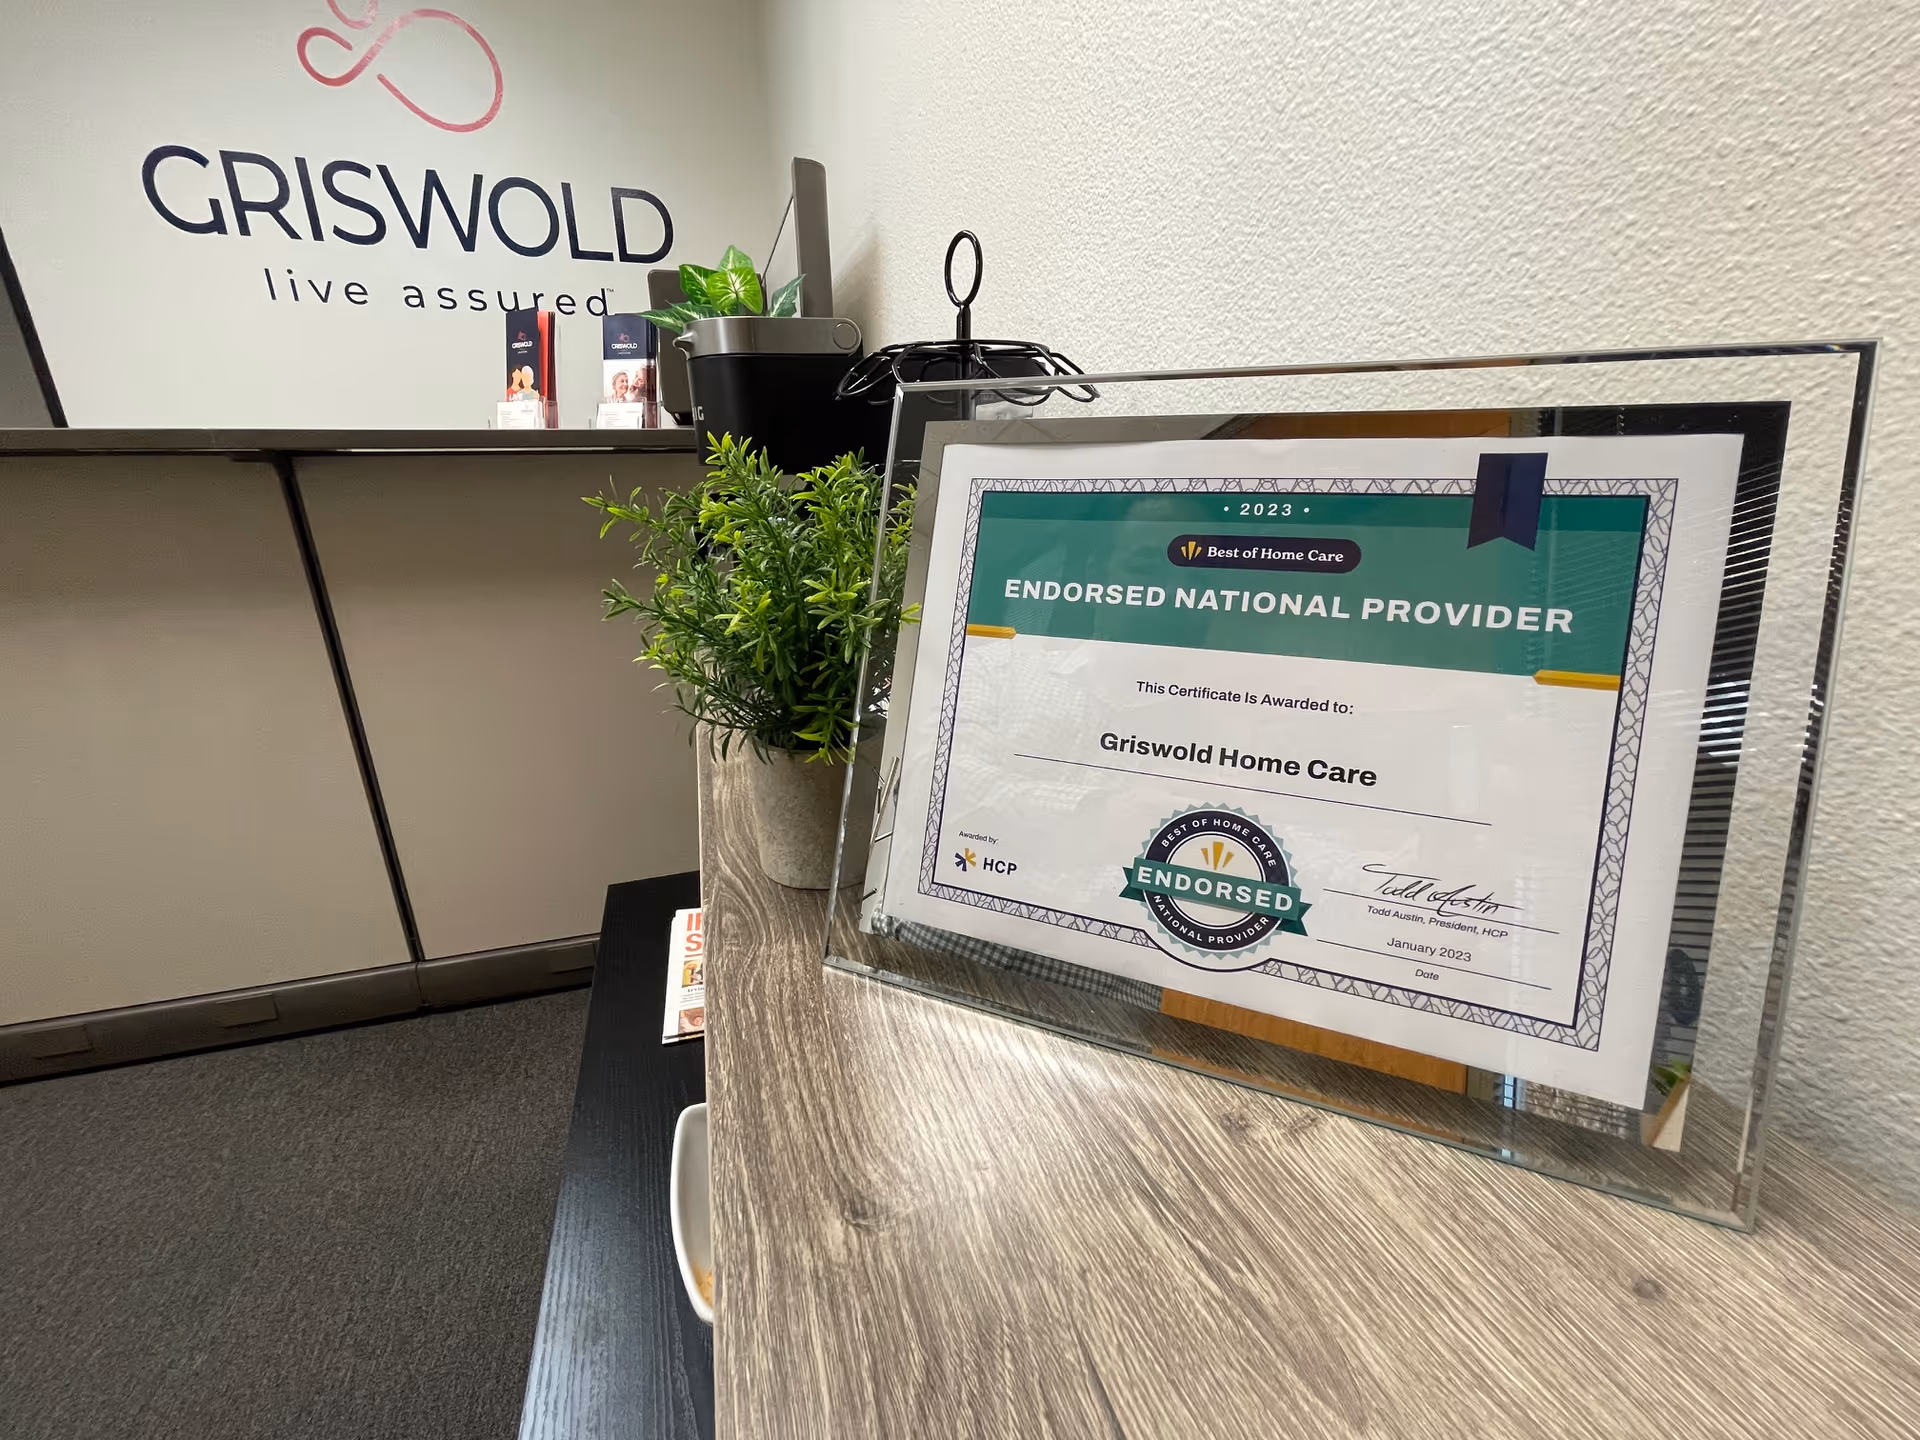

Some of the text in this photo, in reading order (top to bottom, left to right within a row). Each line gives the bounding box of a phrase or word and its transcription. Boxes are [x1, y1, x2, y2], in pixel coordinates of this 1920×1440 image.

[142, 145, 673, 263] GRISWOLD
[264, 267, 369, 306] live
[511, 340, 533, 349] GRISWOLD
[611, 342, 638, 350] GRISWOLD
[1239, 503, 1293, 516] 2023
[1207, 546, 1344, 563] Best of Home Care
[1004, 579, 1574, 634] ENDORSED NATIONAL PROVIDER
[1136, 680, 1354, 715] This Certificate Is Awarded to:
[1100, 732, 1378, 787] Griswold Home Care
[959, 830, 988, 842] Awarded
[1161, 818, 1277, 867] BEST OF HOME CARE
[983, 857, 1018, 875] HCP
[1137, 866, 1293, 912] ENDORSED
[1153, 895, 1269, 944] NATIONAL PROVIDER
[1367, 905, 1508, 939] Todd Austin, President, HCP
[1387, 937, 1472, 963] January 2023
[1415, 968, 1440, 981] Date
